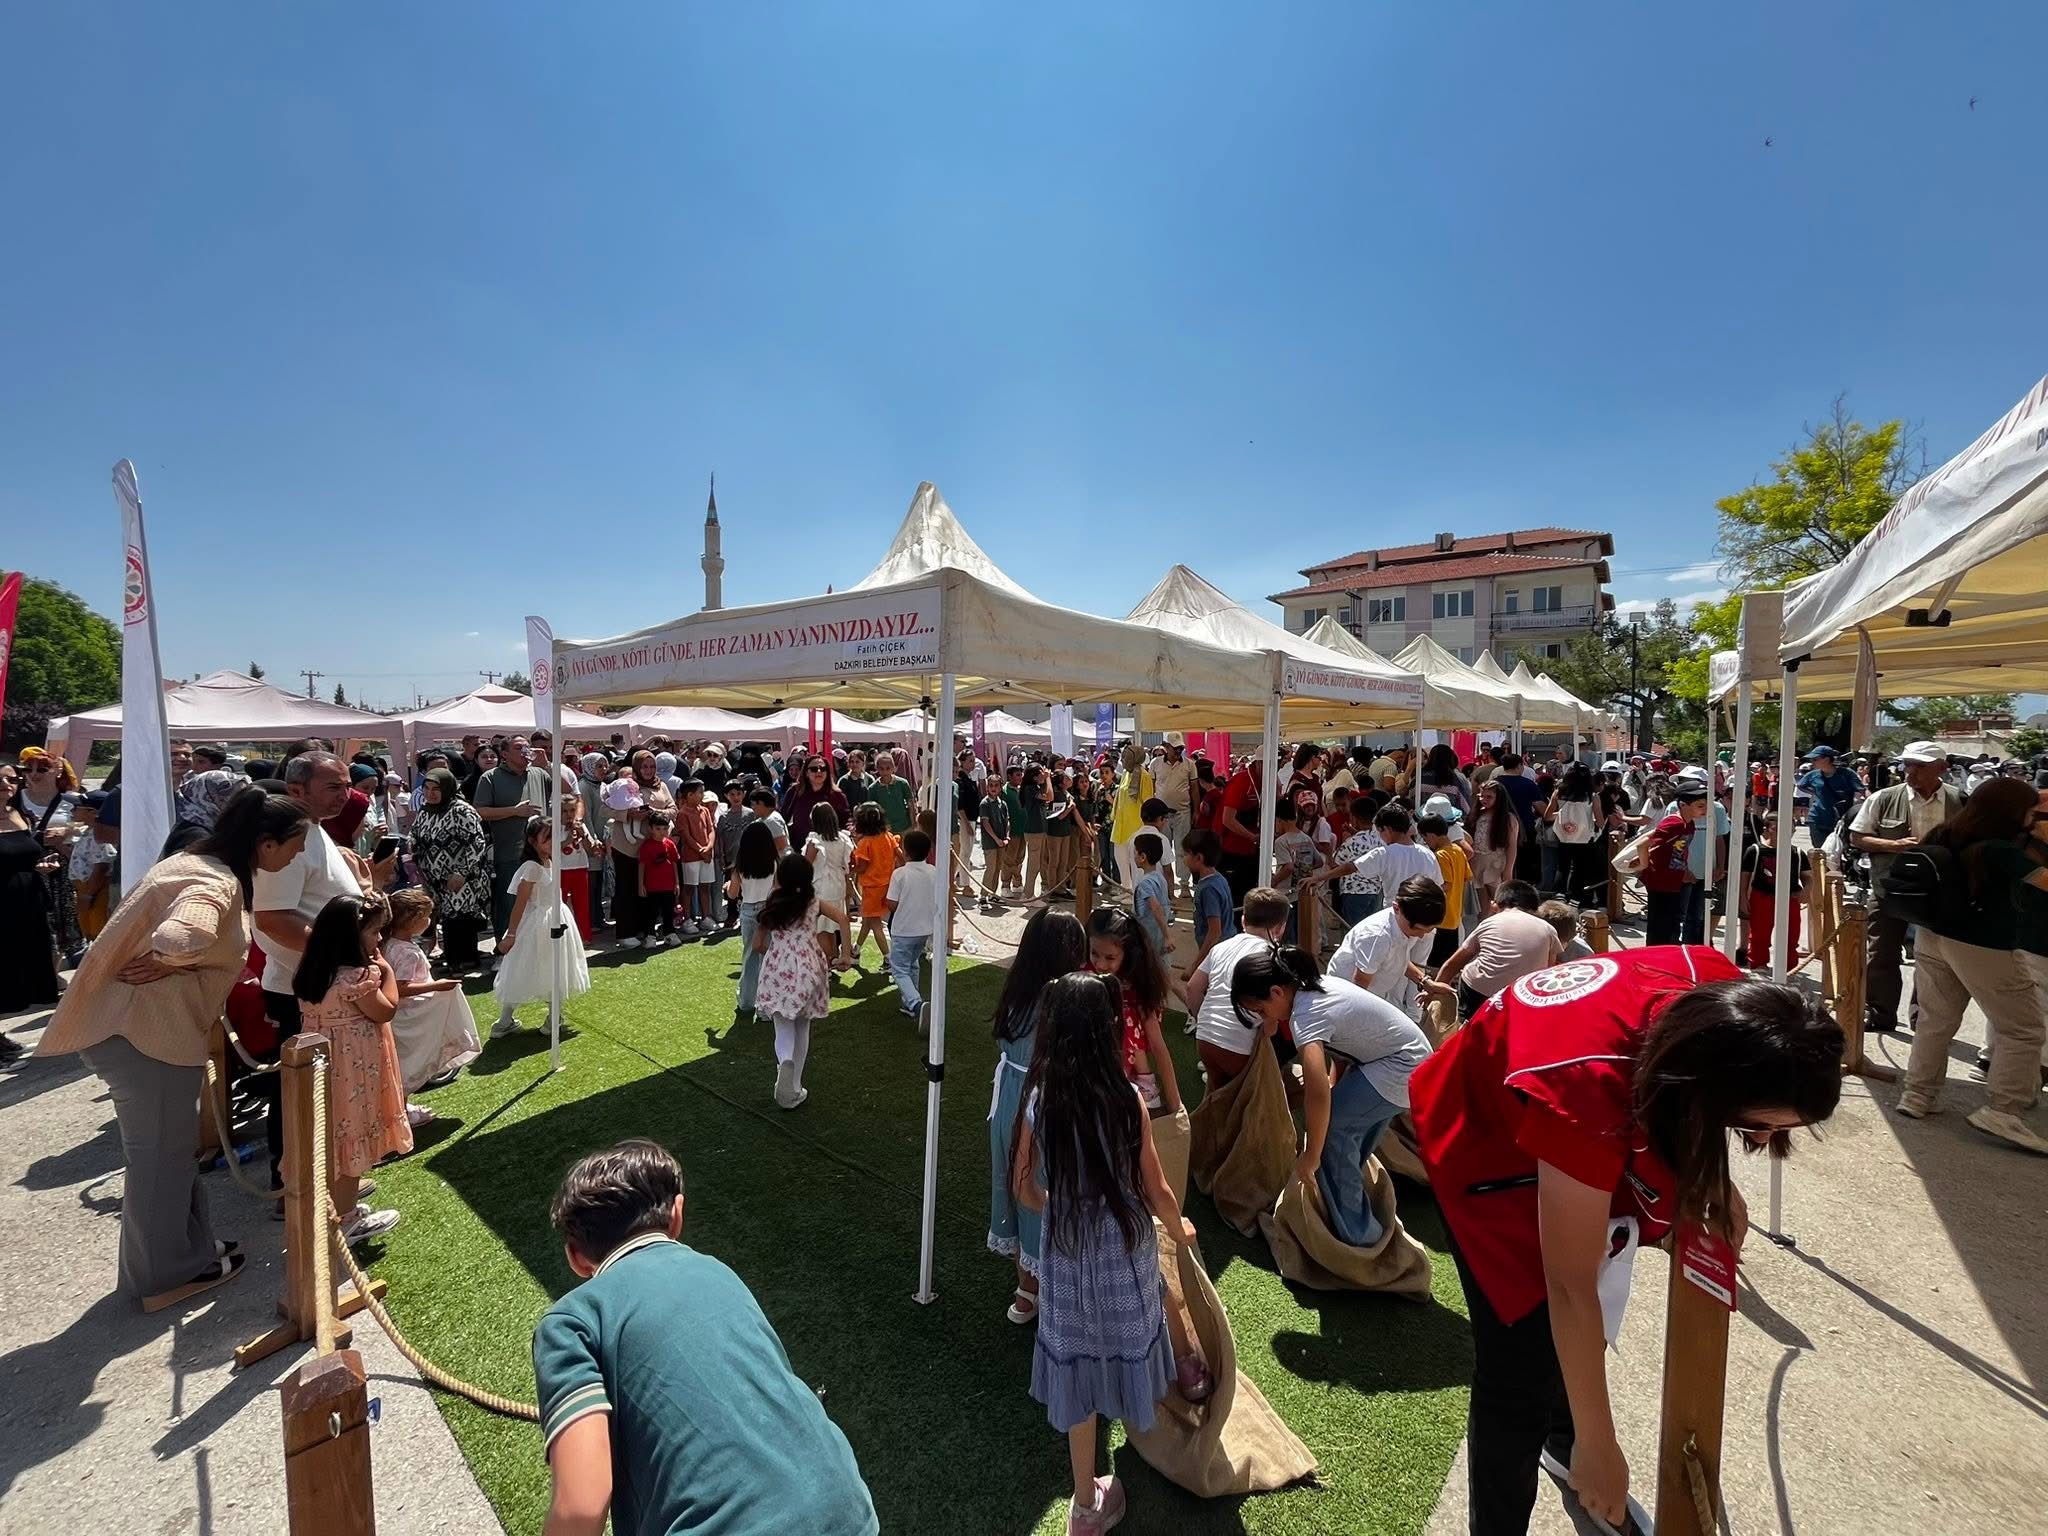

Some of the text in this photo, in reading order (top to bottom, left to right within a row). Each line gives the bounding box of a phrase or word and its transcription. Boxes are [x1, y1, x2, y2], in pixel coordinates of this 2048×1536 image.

[572, 658, 585, 677] İYİ
[622, 645, 652, 669] KÖTÜ
[653, 642, 696, 665] GÜNDE,
[699, 637, 726, 658] HER
[729, 629, 784, 654] ZAMAN
[787, 612, 935, 647] YANINIZDAYIZ...
[857, 641, 906, 654] Fatih ÇİÇEK
[834, 654, 936, 671] DAZKIRI BELEDİYE BAŞKANI
